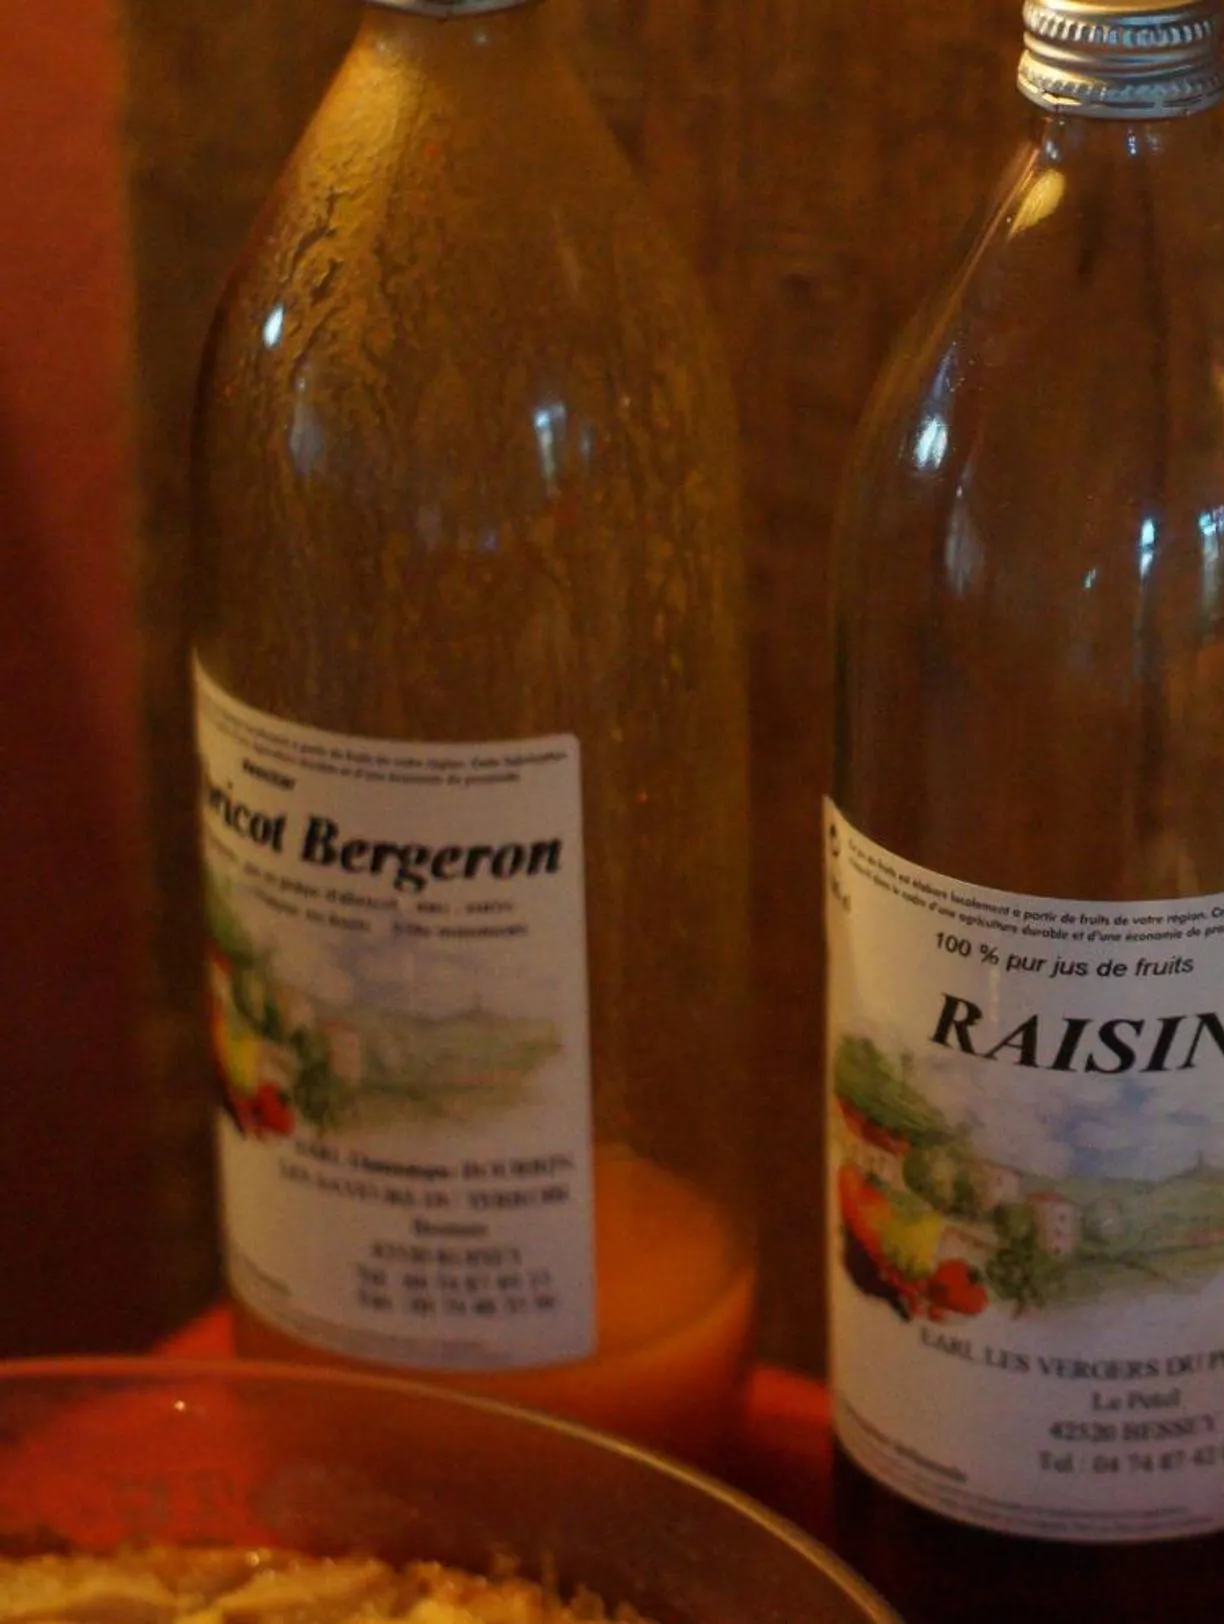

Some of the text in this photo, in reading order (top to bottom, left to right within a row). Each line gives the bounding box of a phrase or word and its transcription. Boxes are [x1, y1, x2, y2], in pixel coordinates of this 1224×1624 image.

[300, 812, 564, 894] Bergeron
[1021, 924, 1070, 941] durable
[1072, 929, 1085, 941] et
[1087, 929, 1122, 943] d'une
[1185, 926, 1202, 939] de
[1023, 908, 1057, 923] partir
[1061, 912, 1077, 925] de
[1080, 913, 1110, 927] fruits
[1113, 914, 1129, 927] de
[1132, 914, 1163, 926] votre
[936, 931, 1195, 978] 100 % pur jus de fruits
[984, 1344, 1031, 1374] LES
[1036, 1355, 1160, 1382] VERGERS
[1165, 1352, 1206, 1378] DU
